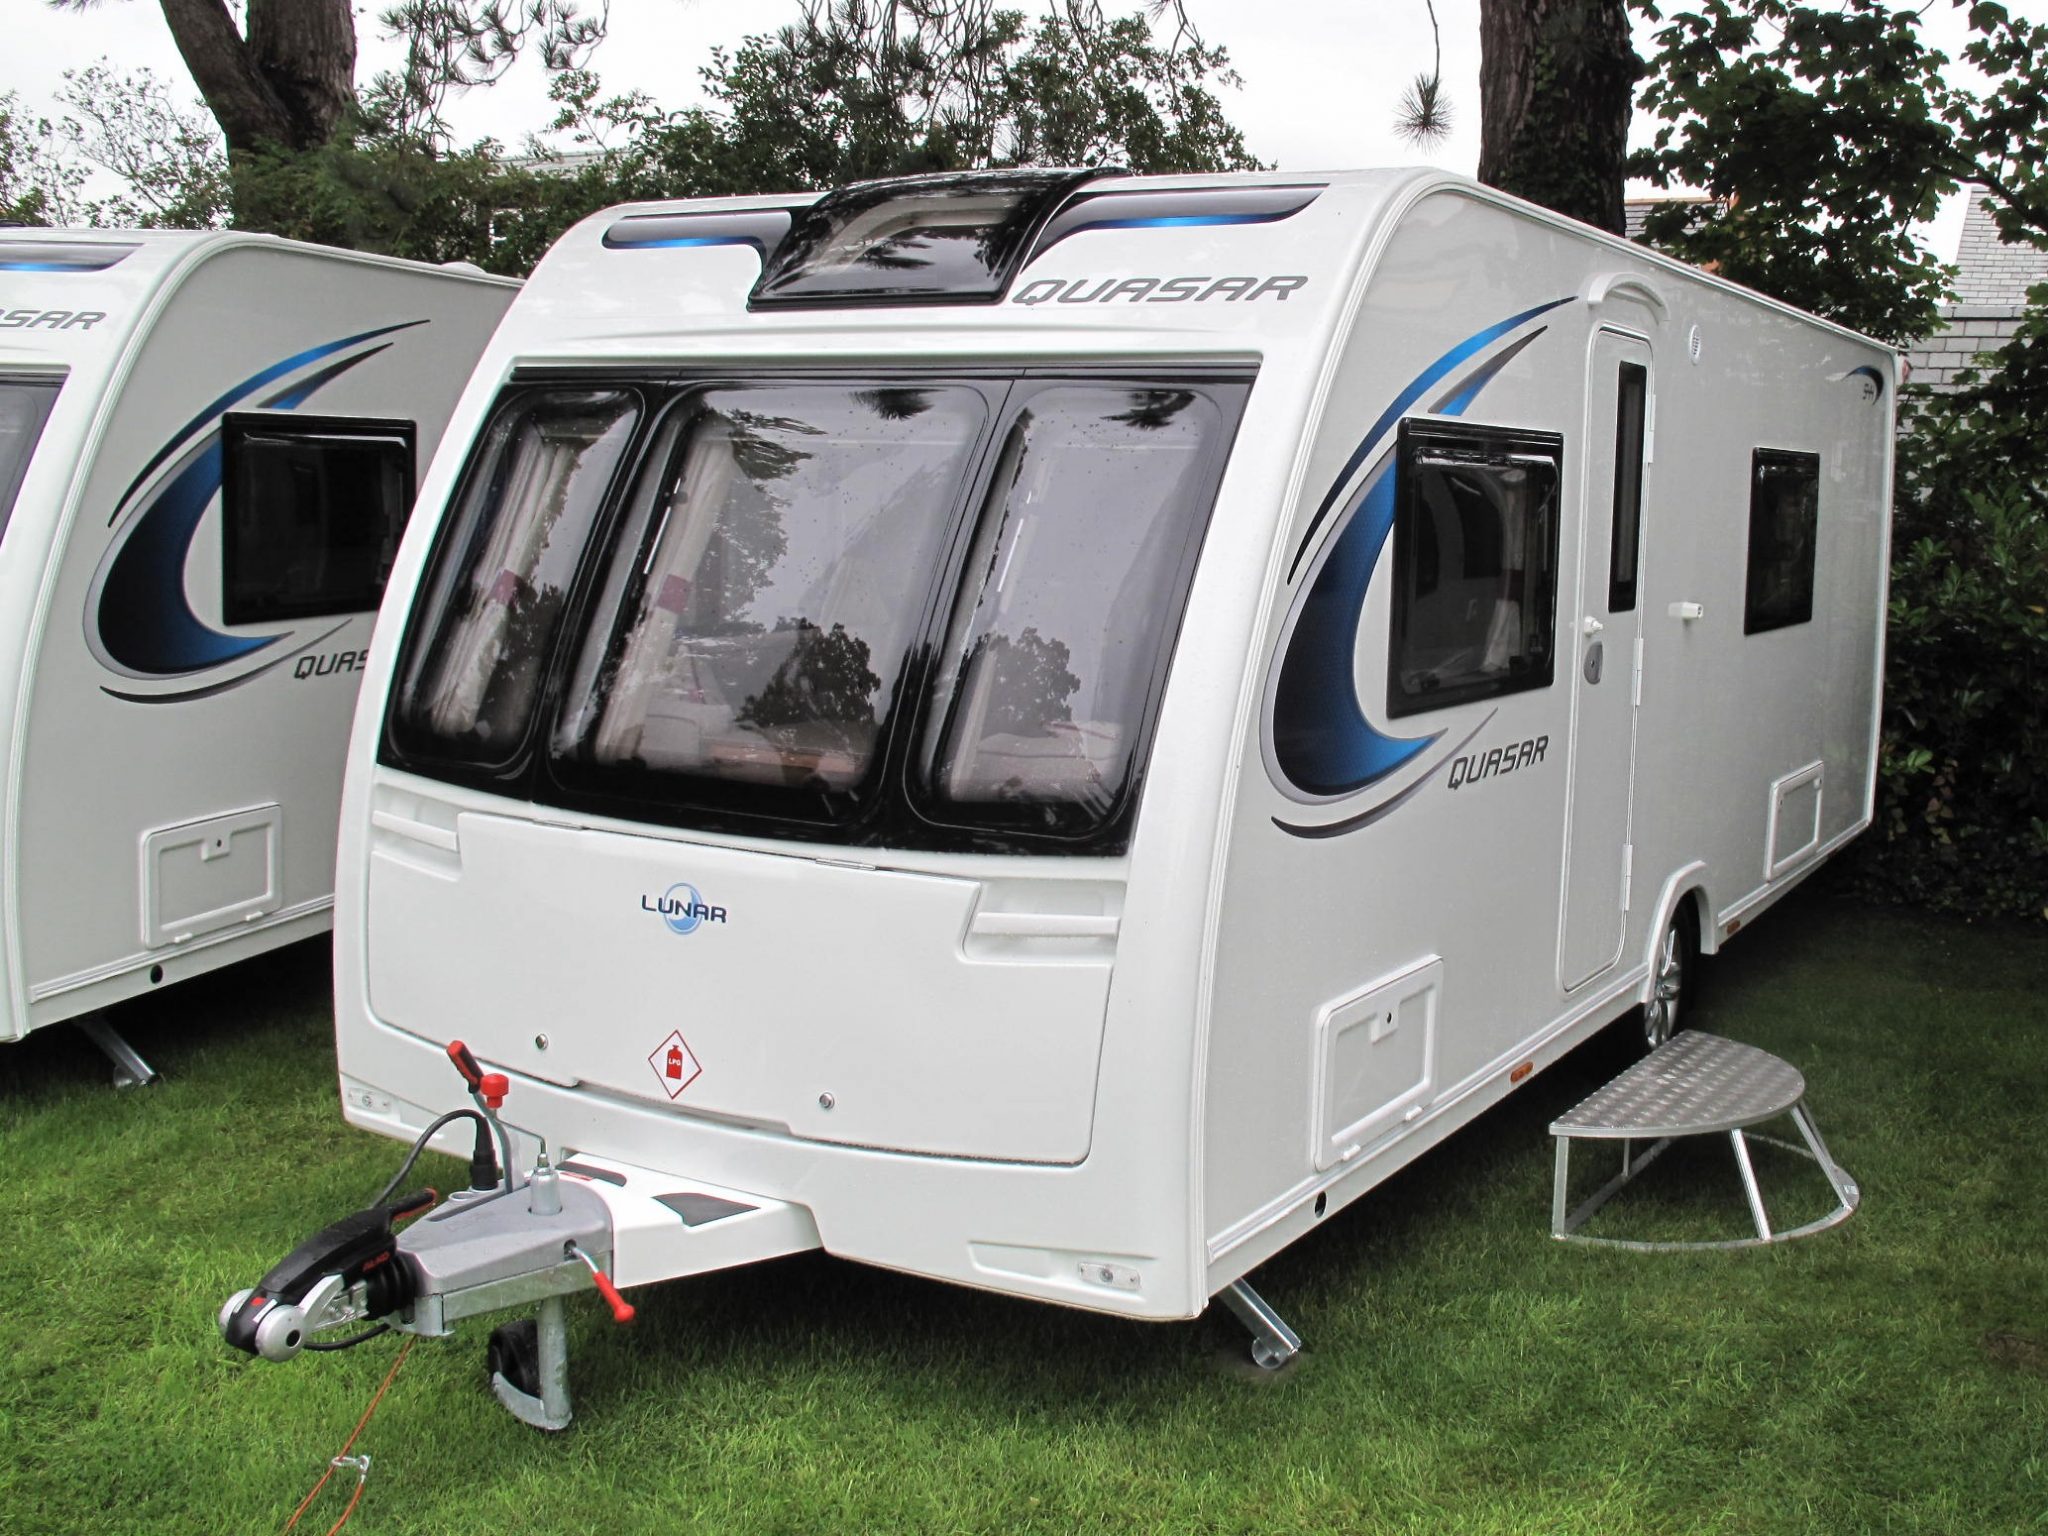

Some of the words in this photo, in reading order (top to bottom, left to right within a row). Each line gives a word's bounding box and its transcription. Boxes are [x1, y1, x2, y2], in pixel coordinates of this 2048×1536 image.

[1011, 275, 1309, 306] QUASAR
[0, 309, 107, 330] SAR
[1447, 734, 1549, 790] QUASAR
[641, 894, 727, 924] LUNAR
